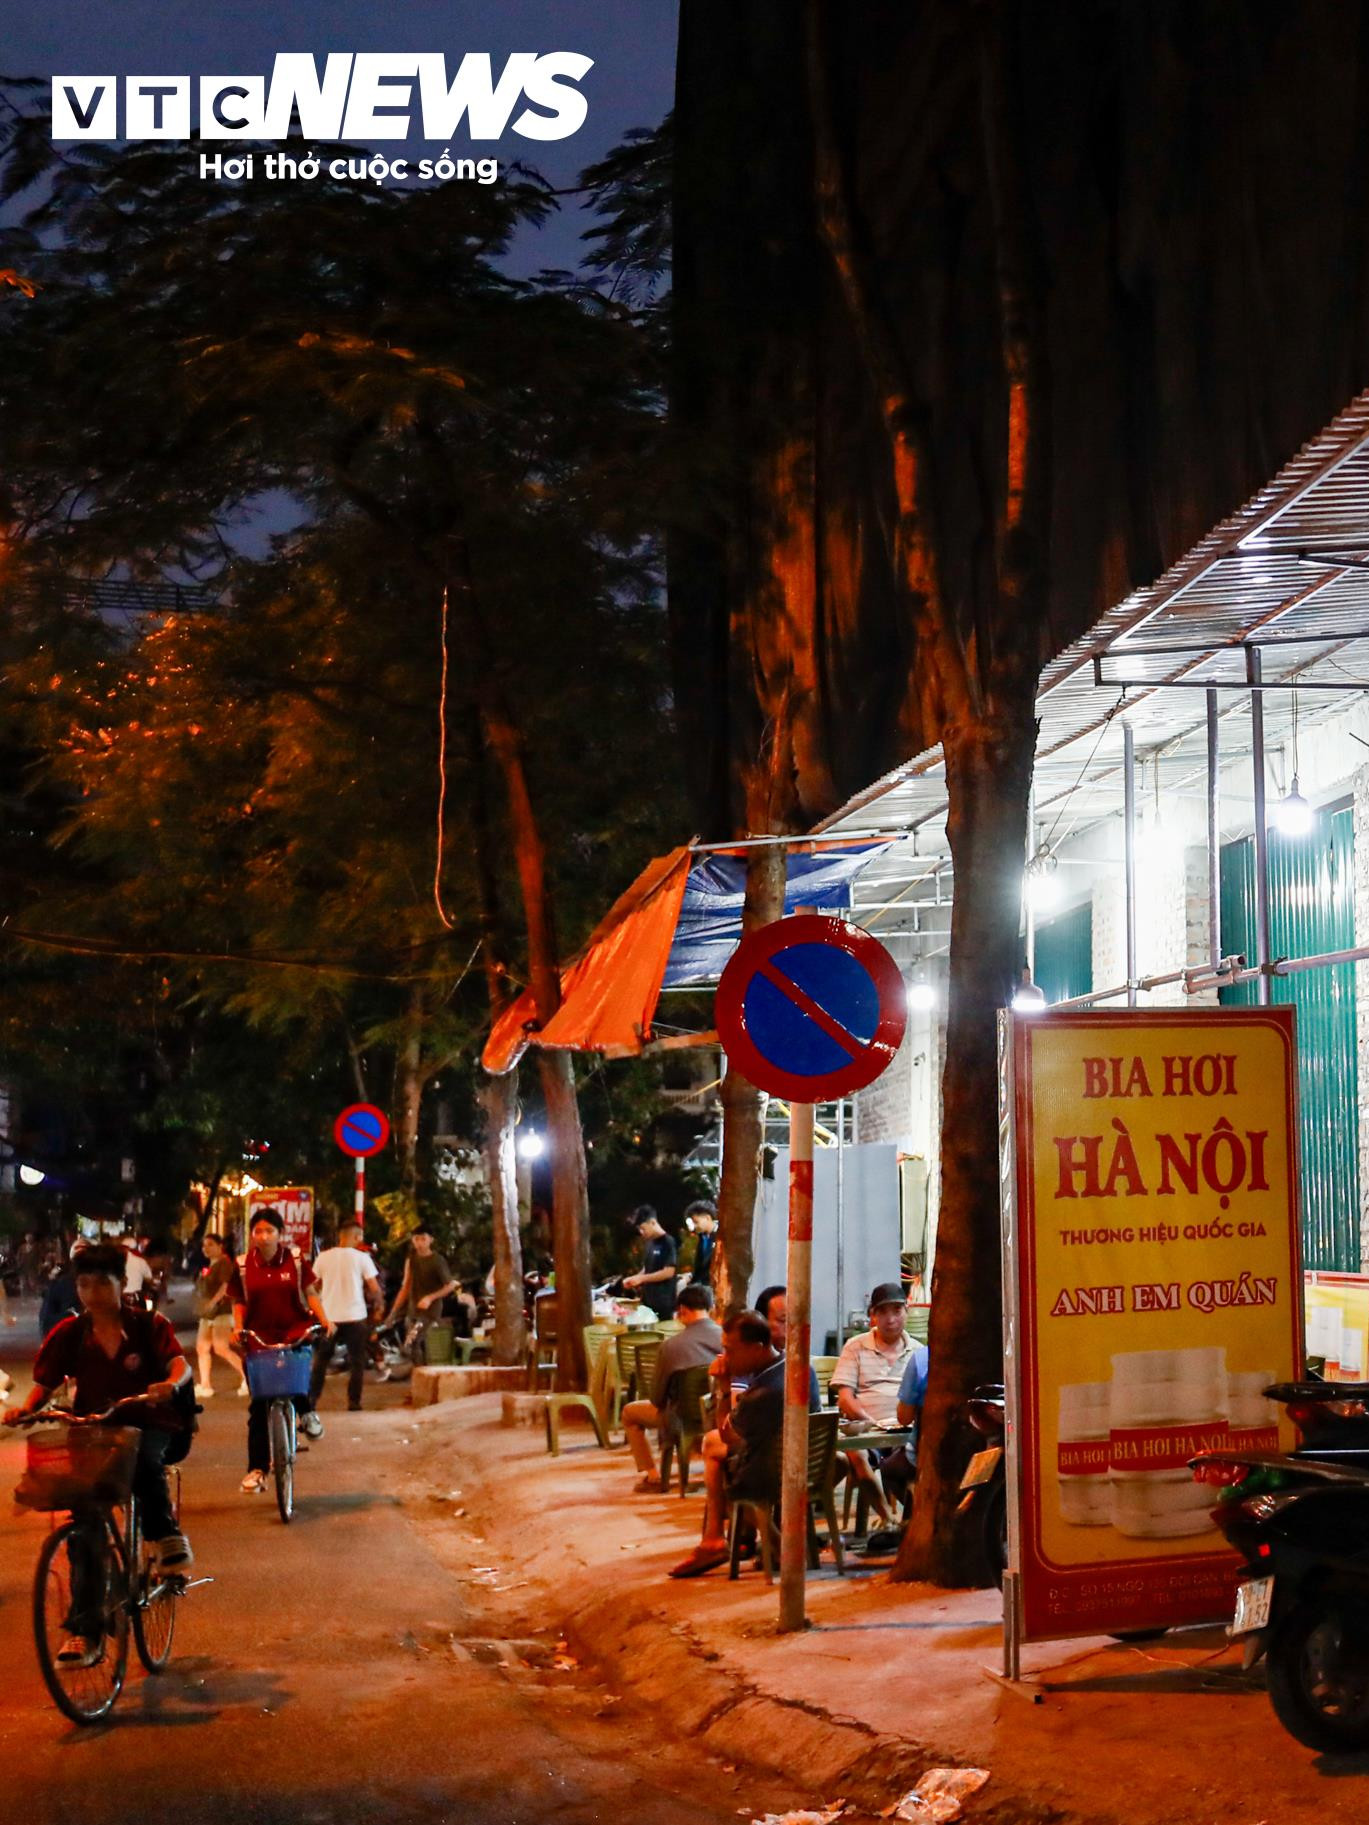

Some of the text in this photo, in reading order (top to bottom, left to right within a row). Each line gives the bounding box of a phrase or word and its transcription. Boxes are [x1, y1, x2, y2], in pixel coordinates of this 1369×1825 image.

[1082, 1053, 1238, 1098] BIA HƠI
[1053, 1116, 1270, 1210] HÀ NỘI
[1059, 1217, 1267, 1246] THƯƠNG HIỆU QUỐC GIA
[1051, 1271, 1278, 1317] ANH EM QUÁN
[1113, 1440, 1139, 1460] BIA
